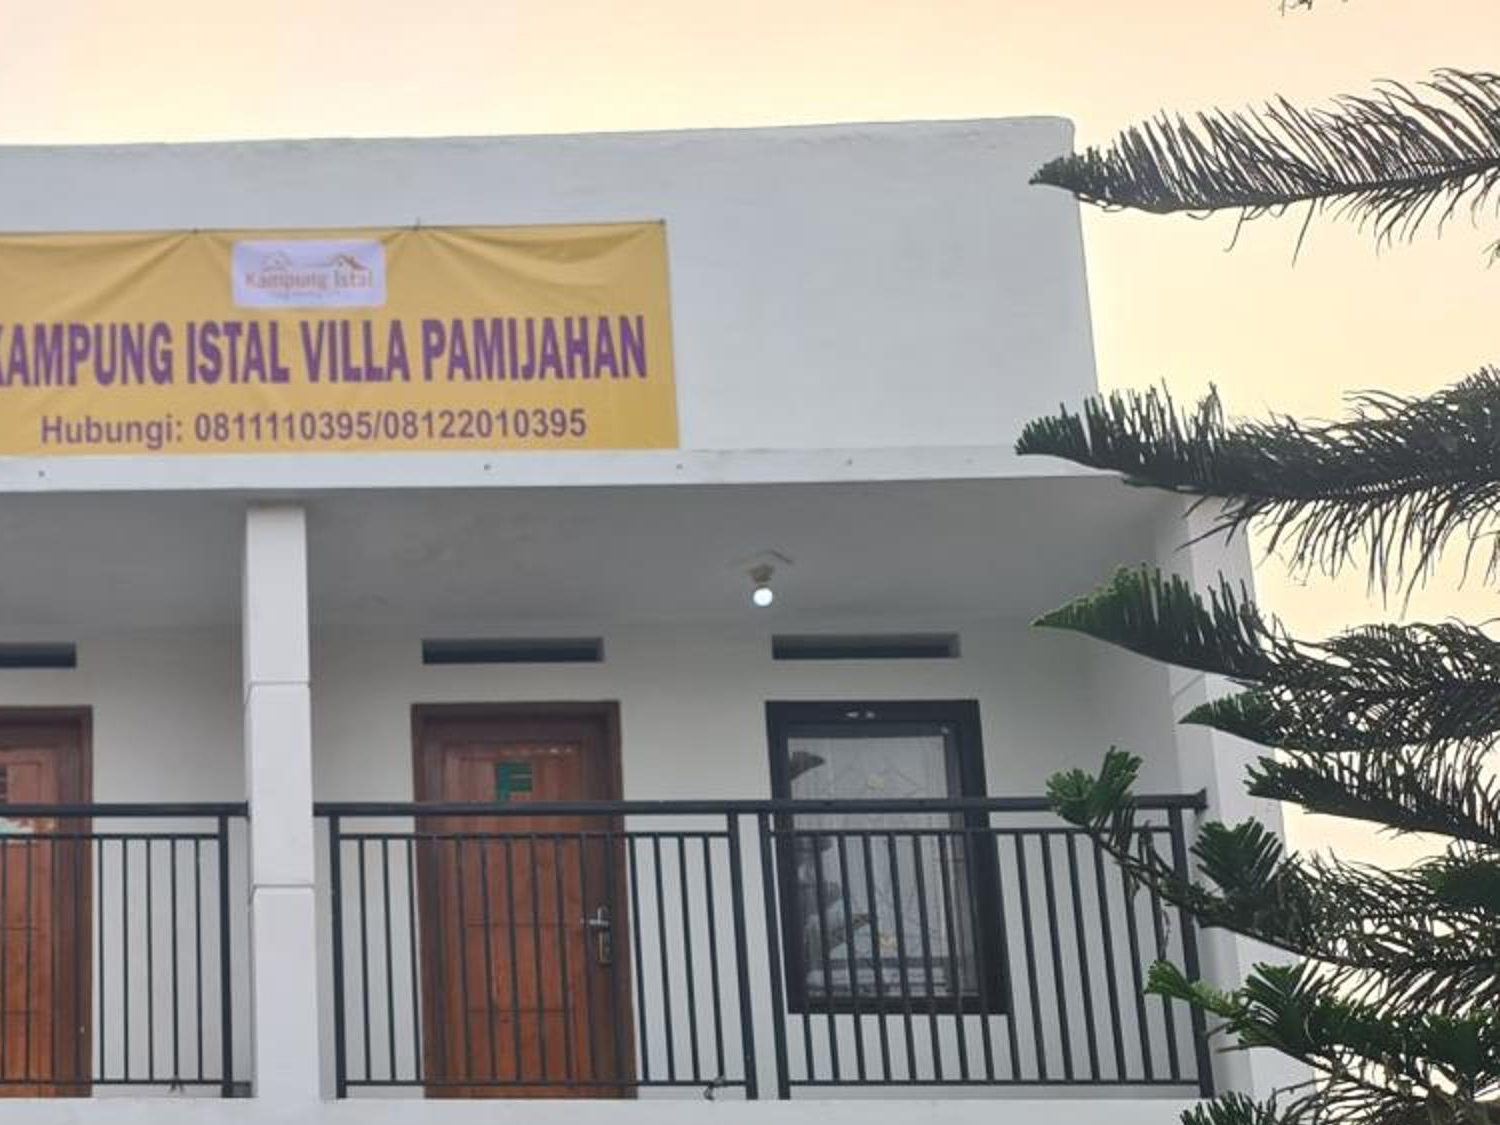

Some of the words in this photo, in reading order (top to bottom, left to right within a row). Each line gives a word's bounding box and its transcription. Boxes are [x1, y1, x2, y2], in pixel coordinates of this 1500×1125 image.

[187, 320, 290, 384] ISTAL
[300, 319, 411, 383] VILLA
[422, 315, 648, 381] PAMIJAHAN
[41, 414, 183, 449] Hubungi:
[194, 408, 587, 441] 0811110395/08122010395
